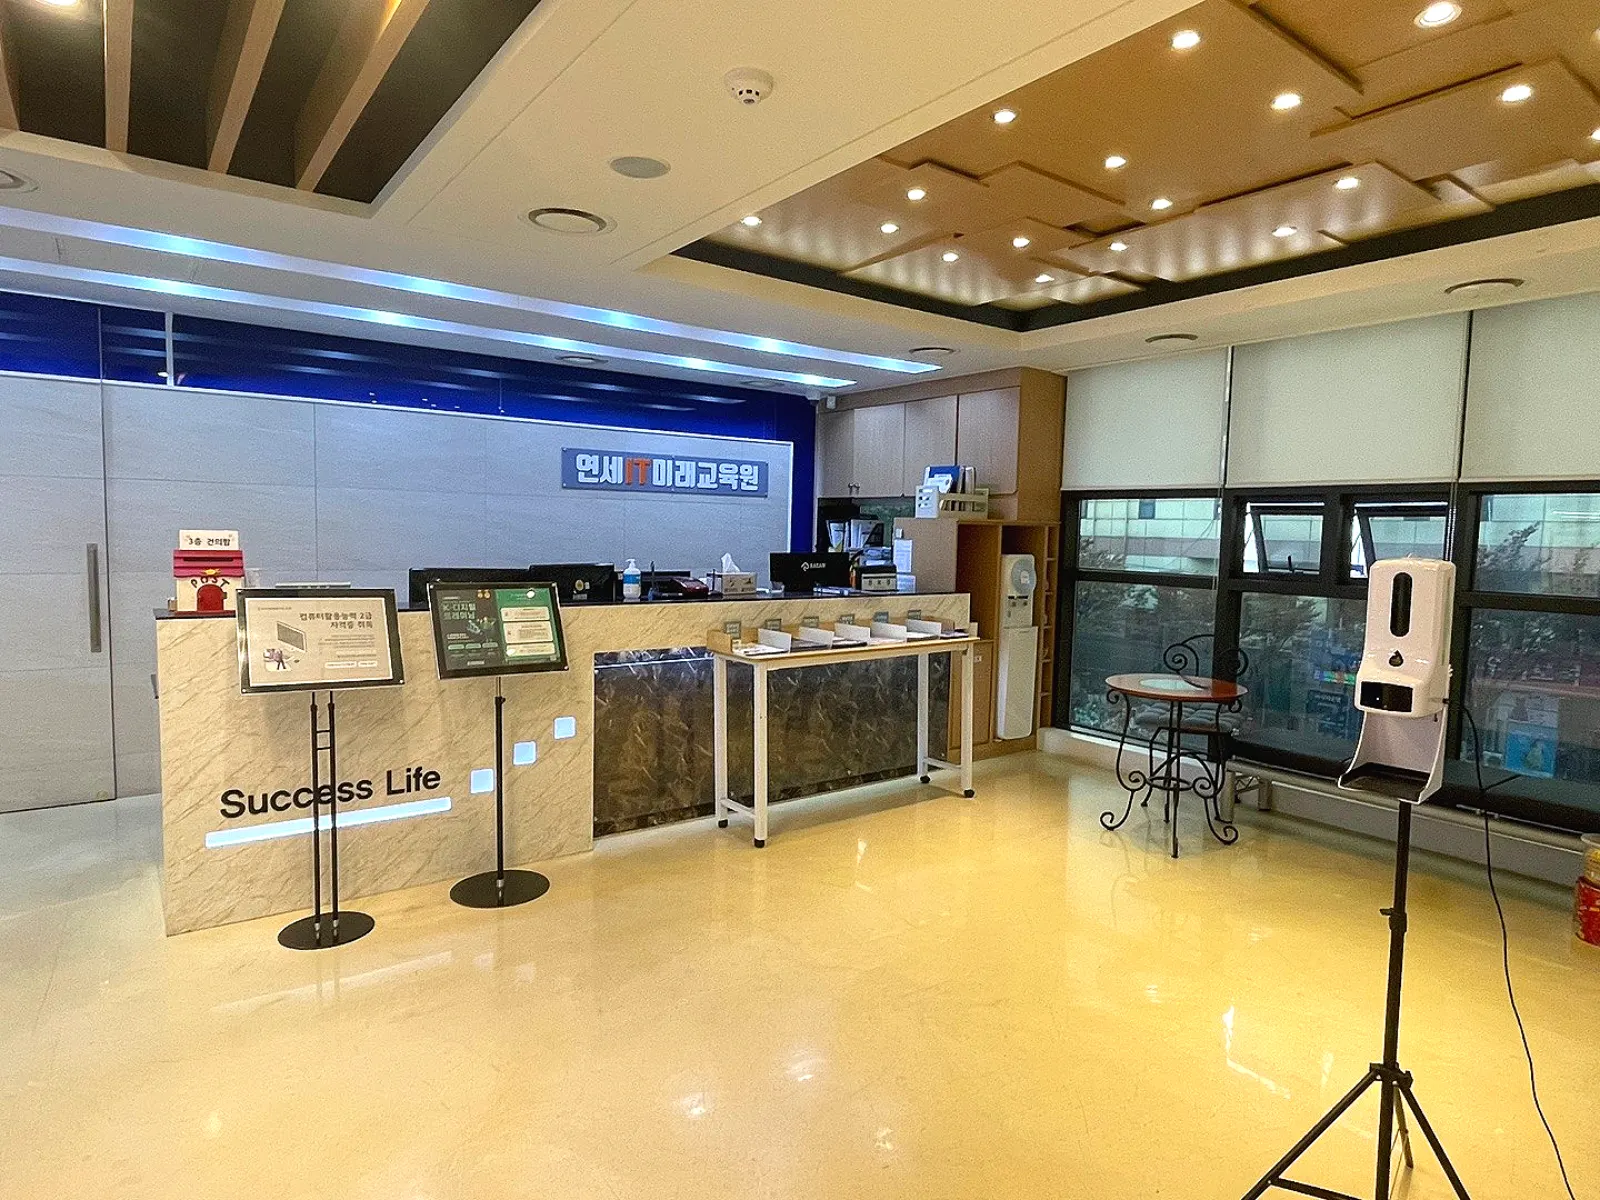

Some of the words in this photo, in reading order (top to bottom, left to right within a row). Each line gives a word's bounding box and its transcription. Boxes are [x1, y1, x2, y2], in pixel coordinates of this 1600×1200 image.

[576, 453, 759, 491] 연세IT미래교육원
[190, 576, 231, 588] POST
[220, 779, 374, 819] Success
[386, 766, 441, 795] Life
